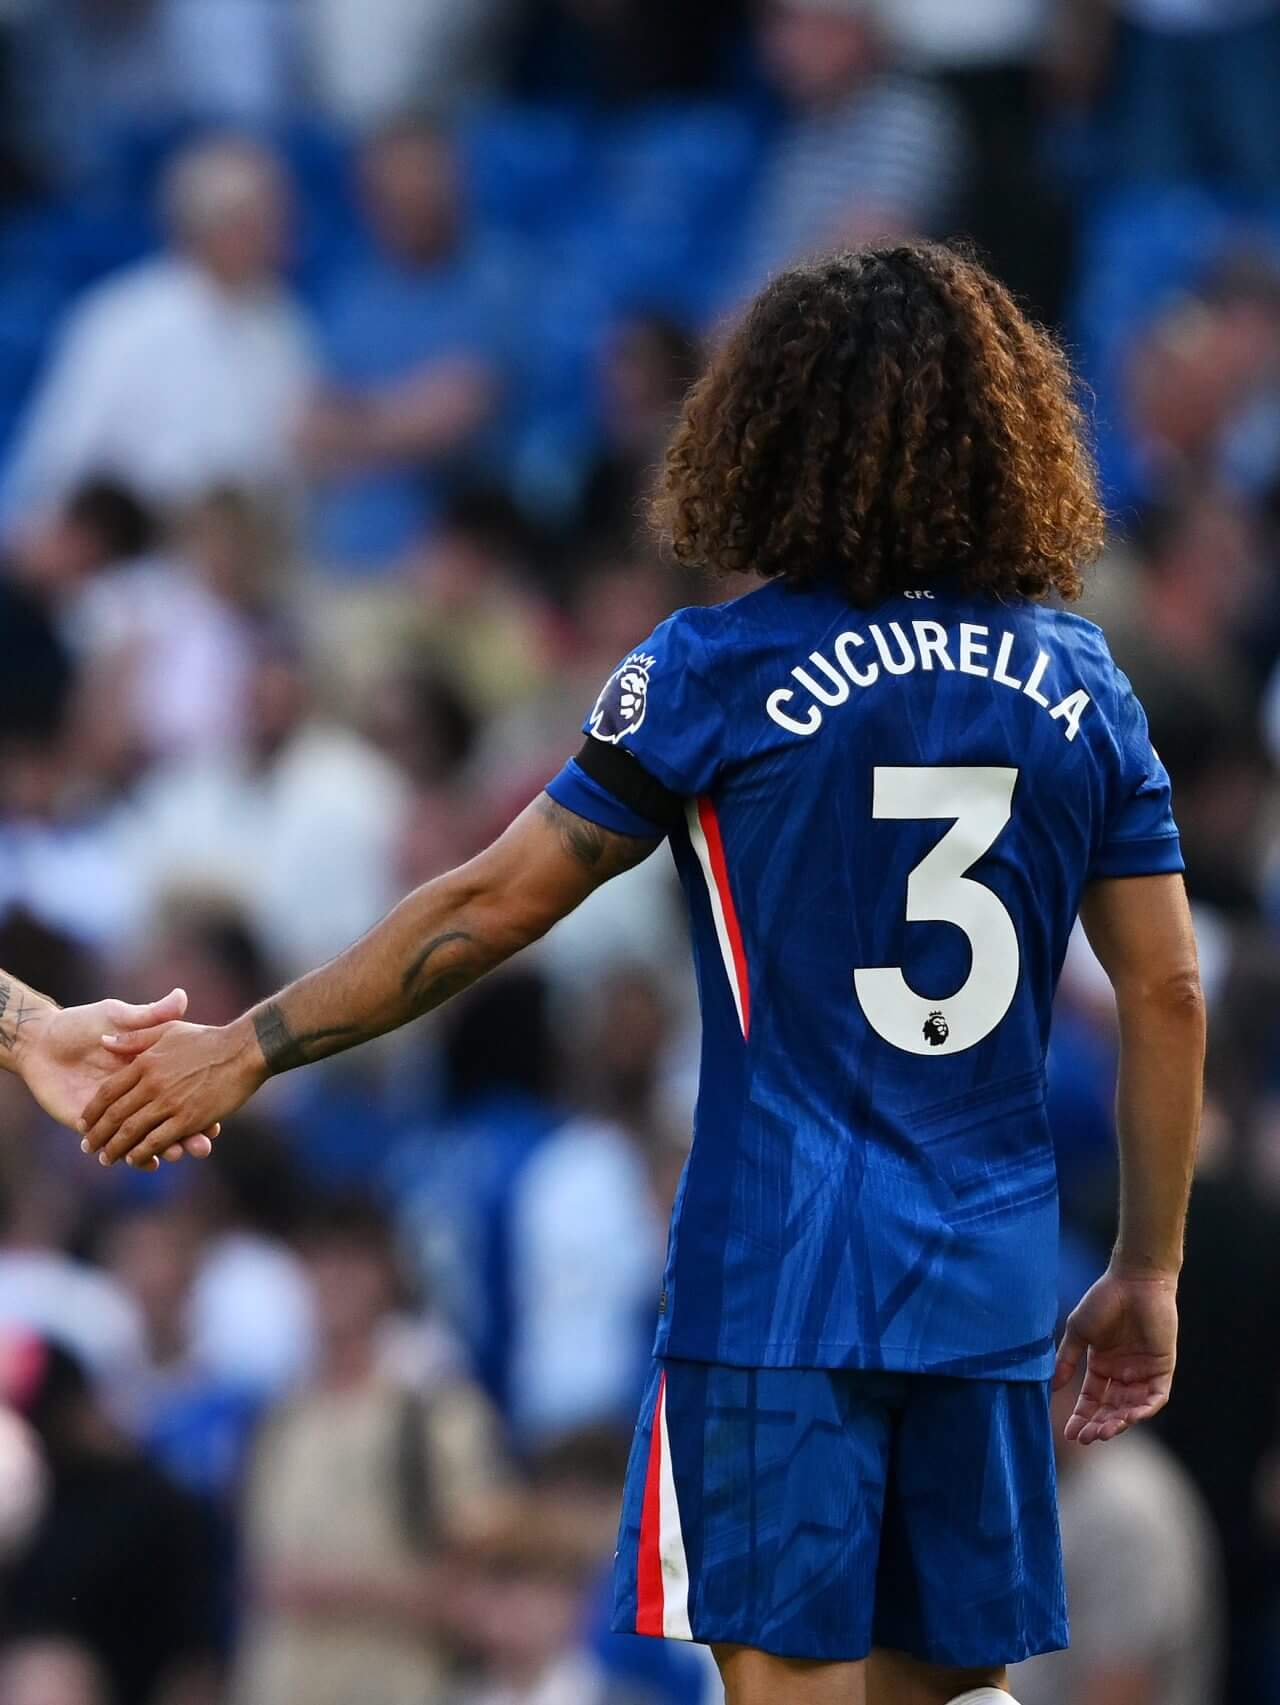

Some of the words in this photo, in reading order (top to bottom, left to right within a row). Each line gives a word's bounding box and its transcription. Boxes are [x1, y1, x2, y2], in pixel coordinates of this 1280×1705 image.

[903, 590, 935, 599] CFC
[766, 620, 1090, 742] CUCURELLA
[853, 766, 1020, 1056] 3
